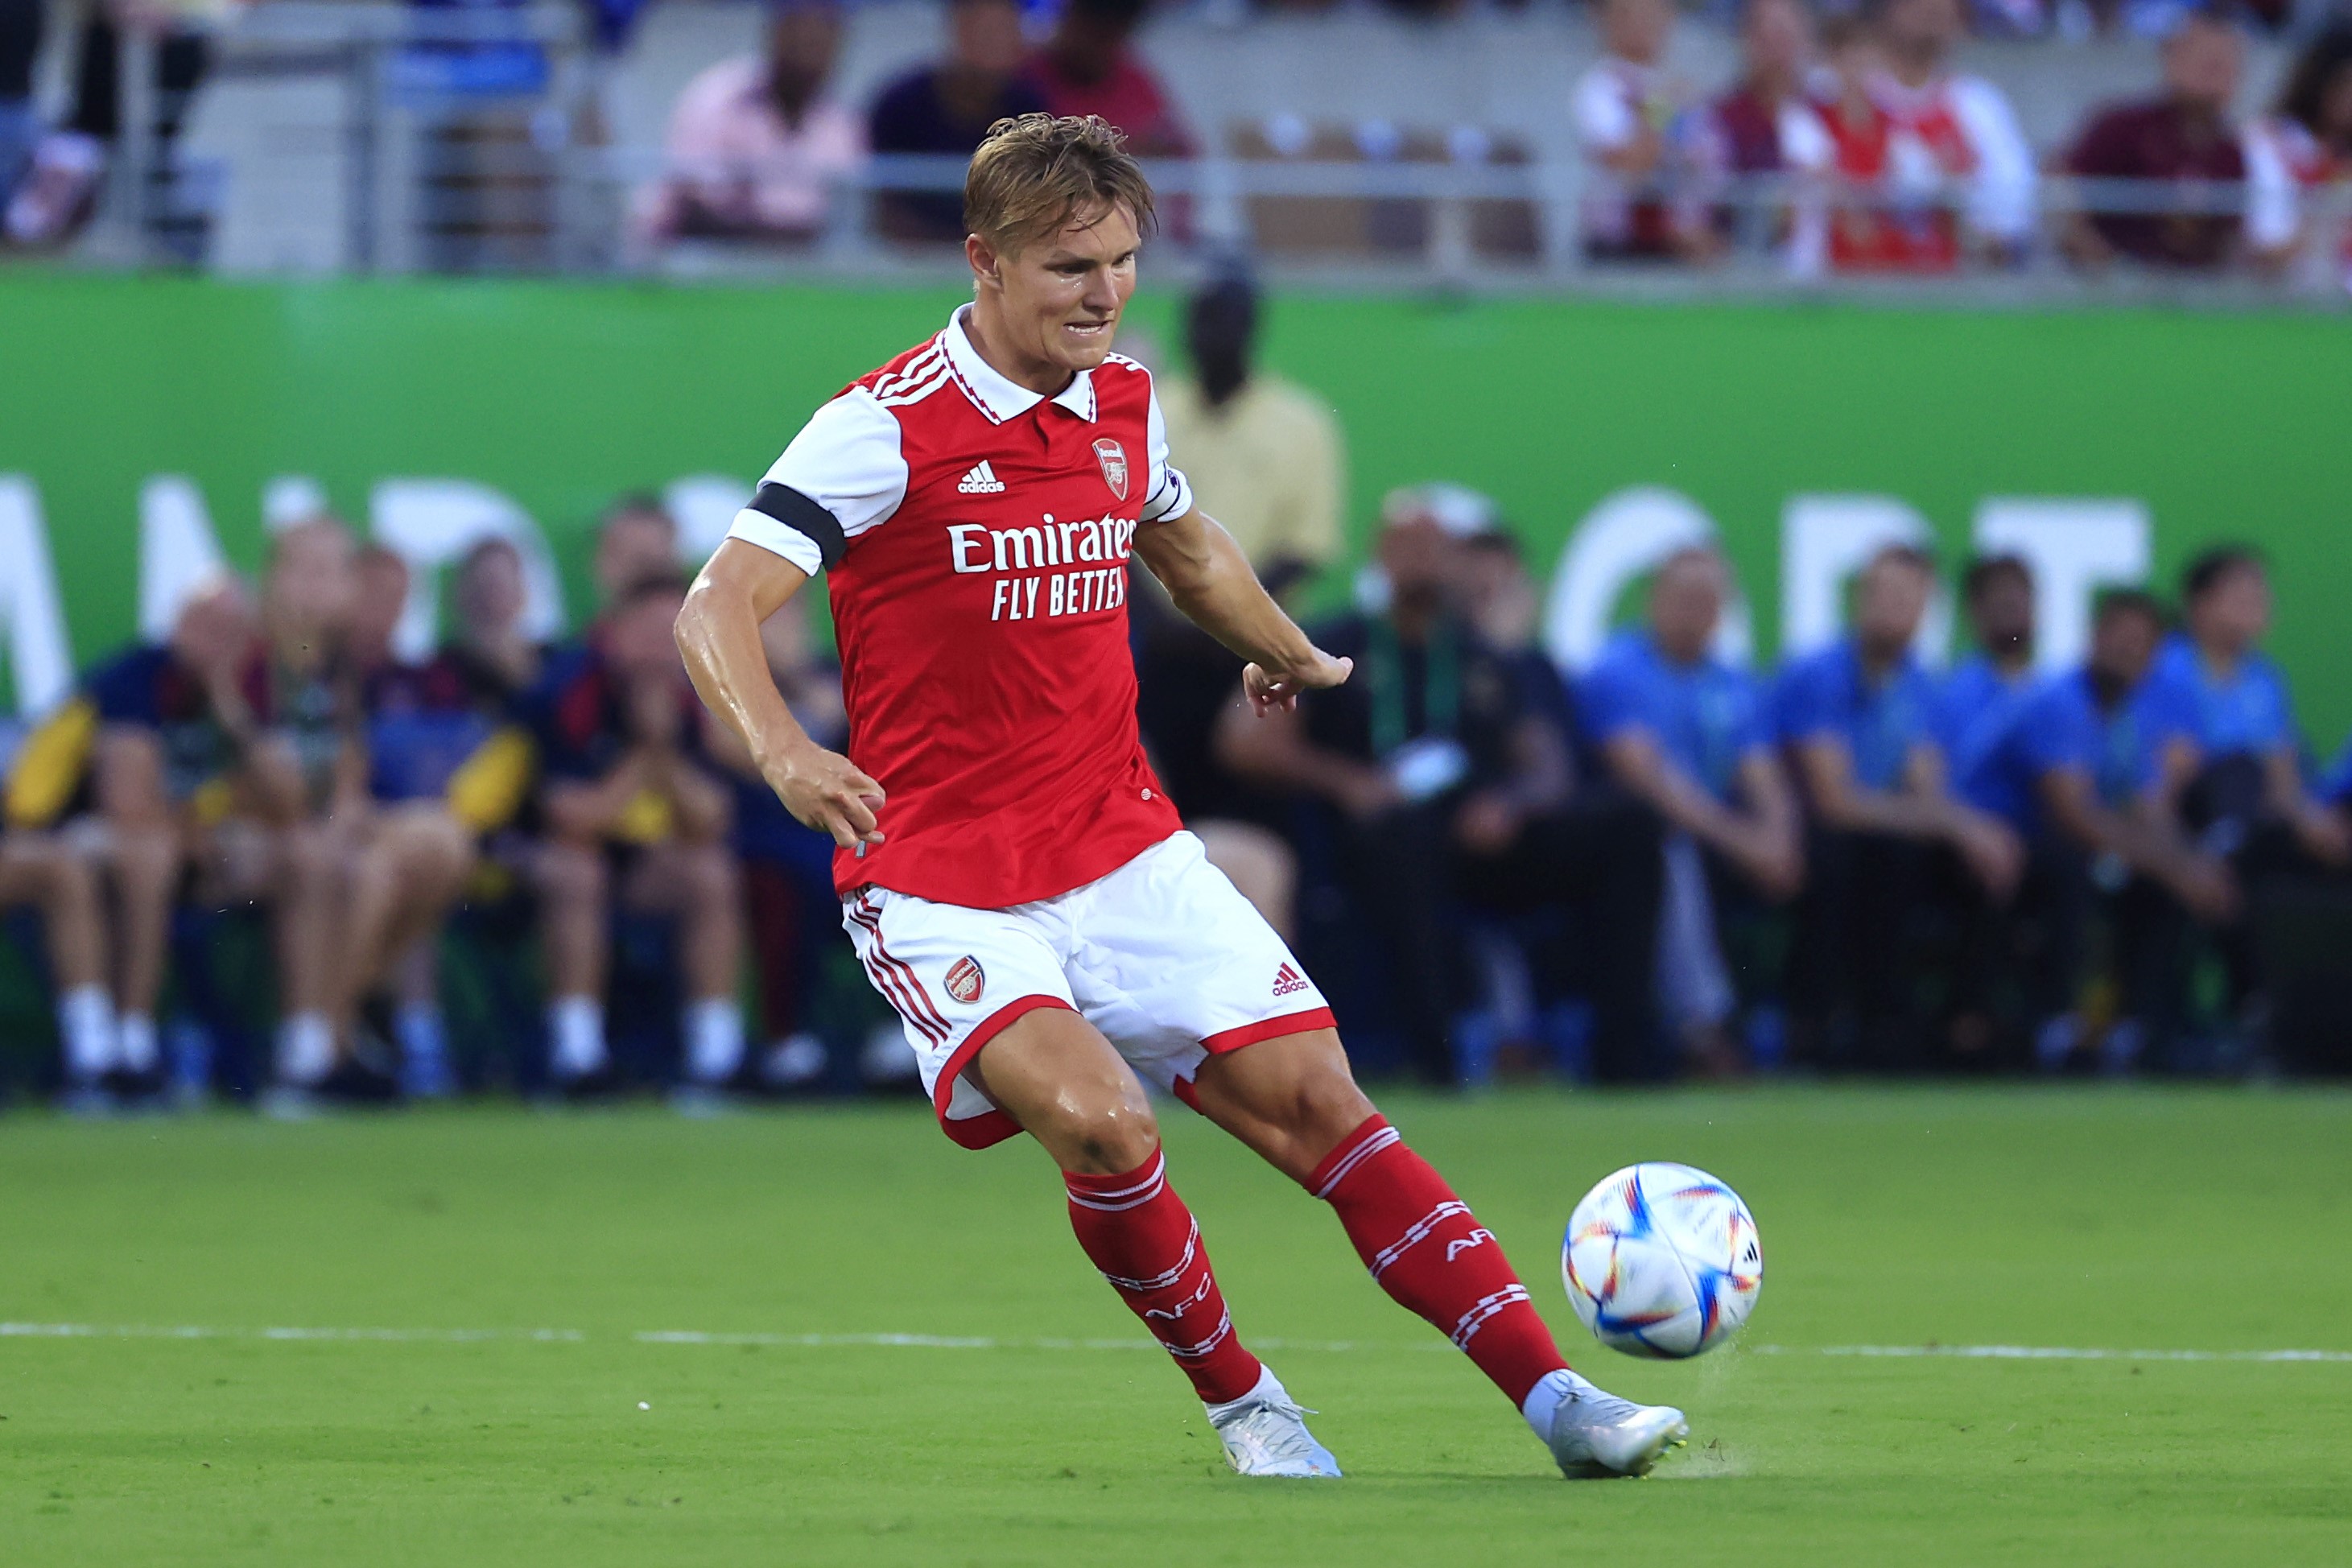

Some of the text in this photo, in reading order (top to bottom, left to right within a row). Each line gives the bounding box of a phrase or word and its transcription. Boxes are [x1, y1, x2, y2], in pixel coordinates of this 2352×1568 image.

[957, 481, 1005, 493] adidas
[991, 576, 1040, 621] FLY
[1273, 980, 1309, 997] adidas
[1446, 1228, 1496, 1262] AF
